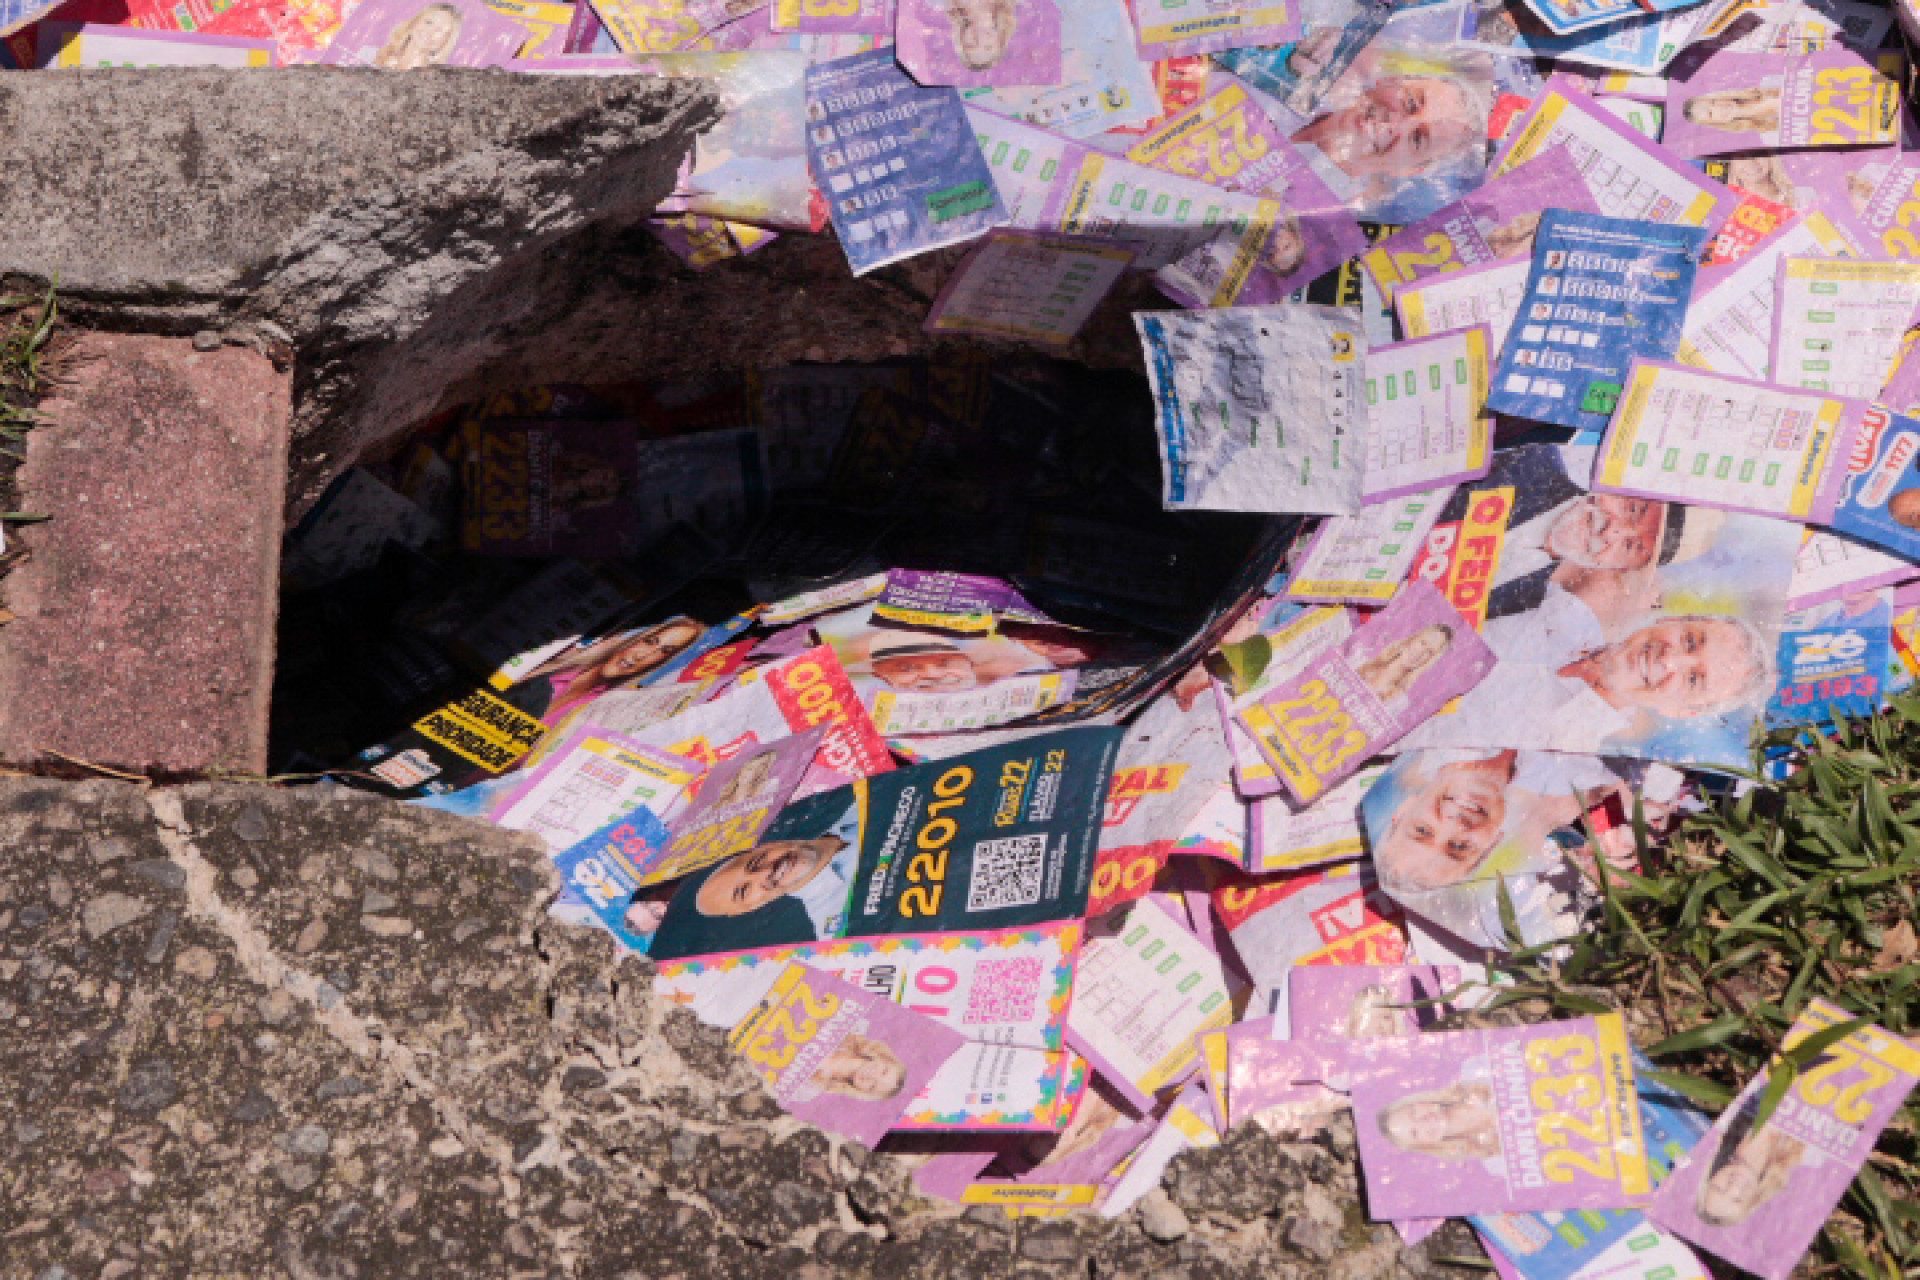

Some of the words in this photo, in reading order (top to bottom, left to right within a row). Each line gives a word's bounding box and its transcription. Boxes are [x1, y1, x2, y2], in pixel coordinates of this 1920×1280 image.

[1168, 108, 1269, 184] 223
[1269, 679, 1367, 775] 2233
[864, 868, 888, 917] FRED
[879, 785, 917, 857] PACHECO
[899, 764, 976, 919] 22010
[746, 982, 839, 1085] 223
[908, 963, 958, 1017] 10
[1503, 1039, 1532, 1125] CUNHA
[1525, 1034, 1617, 1184] 2233
[1515, 1129, 1545, 1189] DANI
